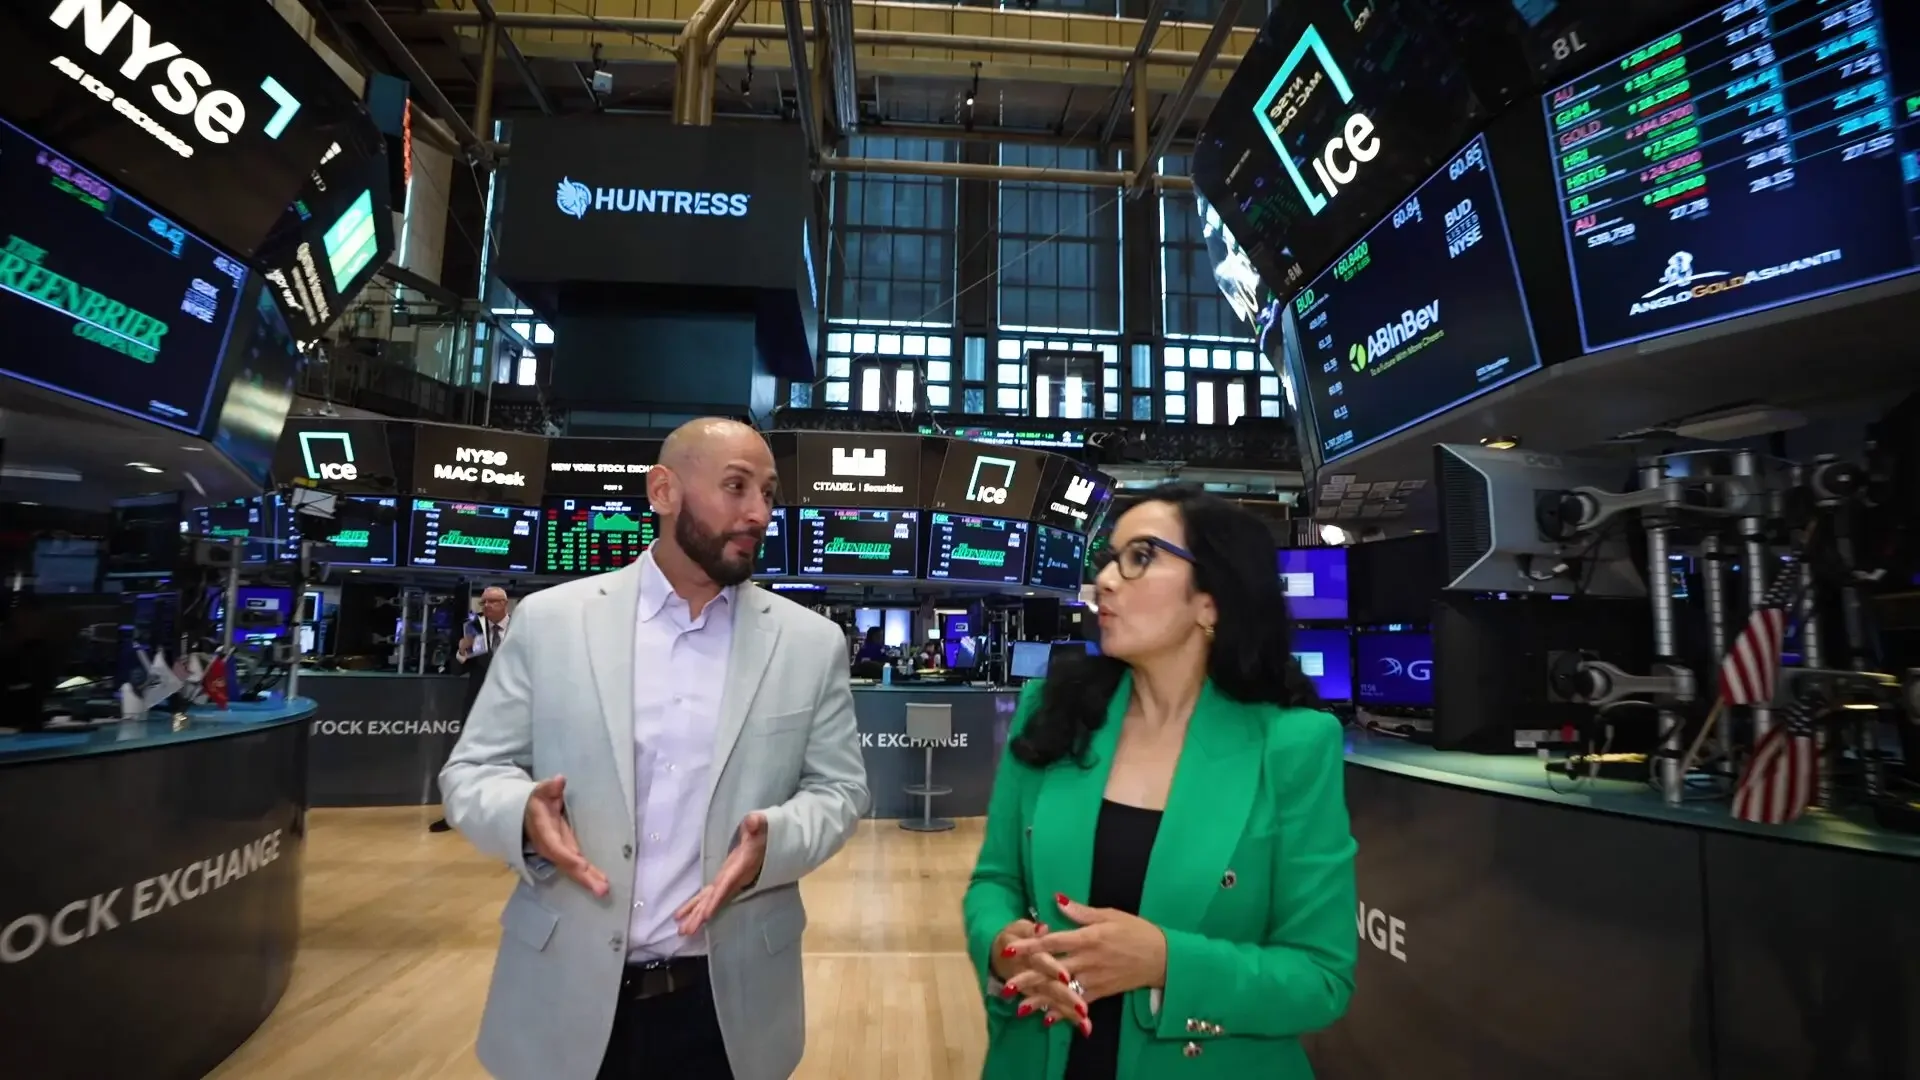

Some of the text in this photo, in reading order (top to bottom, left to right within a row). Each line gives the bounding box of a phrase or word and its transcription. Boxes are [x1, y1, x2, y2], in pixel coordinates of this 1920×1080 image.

[1552, 31, 1587, 60] 8L
[1559, 120, 1601, 146] GOLD
[1393, 142, 1483, 229] 60.84 60.85
[1566, 164, 1608, 190] HRTG
[595, 187, 749, 218] HUNTRESS
[1445, 199, 1473, 228] BUD
[1574, 214, 1597, 232] AU
[1448, 226, 1483, 259] NYSE
[1296, 289, 1315, 314] BUD
[433, 464, 525, 486] MAC Desk
[551, 463, 572, 471] NEW
[572, 463, 596, 472] YORK
[597, 464, 626, 472] STOCK
[812, 482, 904, 493] CITADEL Securities
[438, 534, 511, 550] GREENBRIER
[824, 542, 892, 554] GREENBRIER
[131, 828, 283, 923] EXCHANGE
